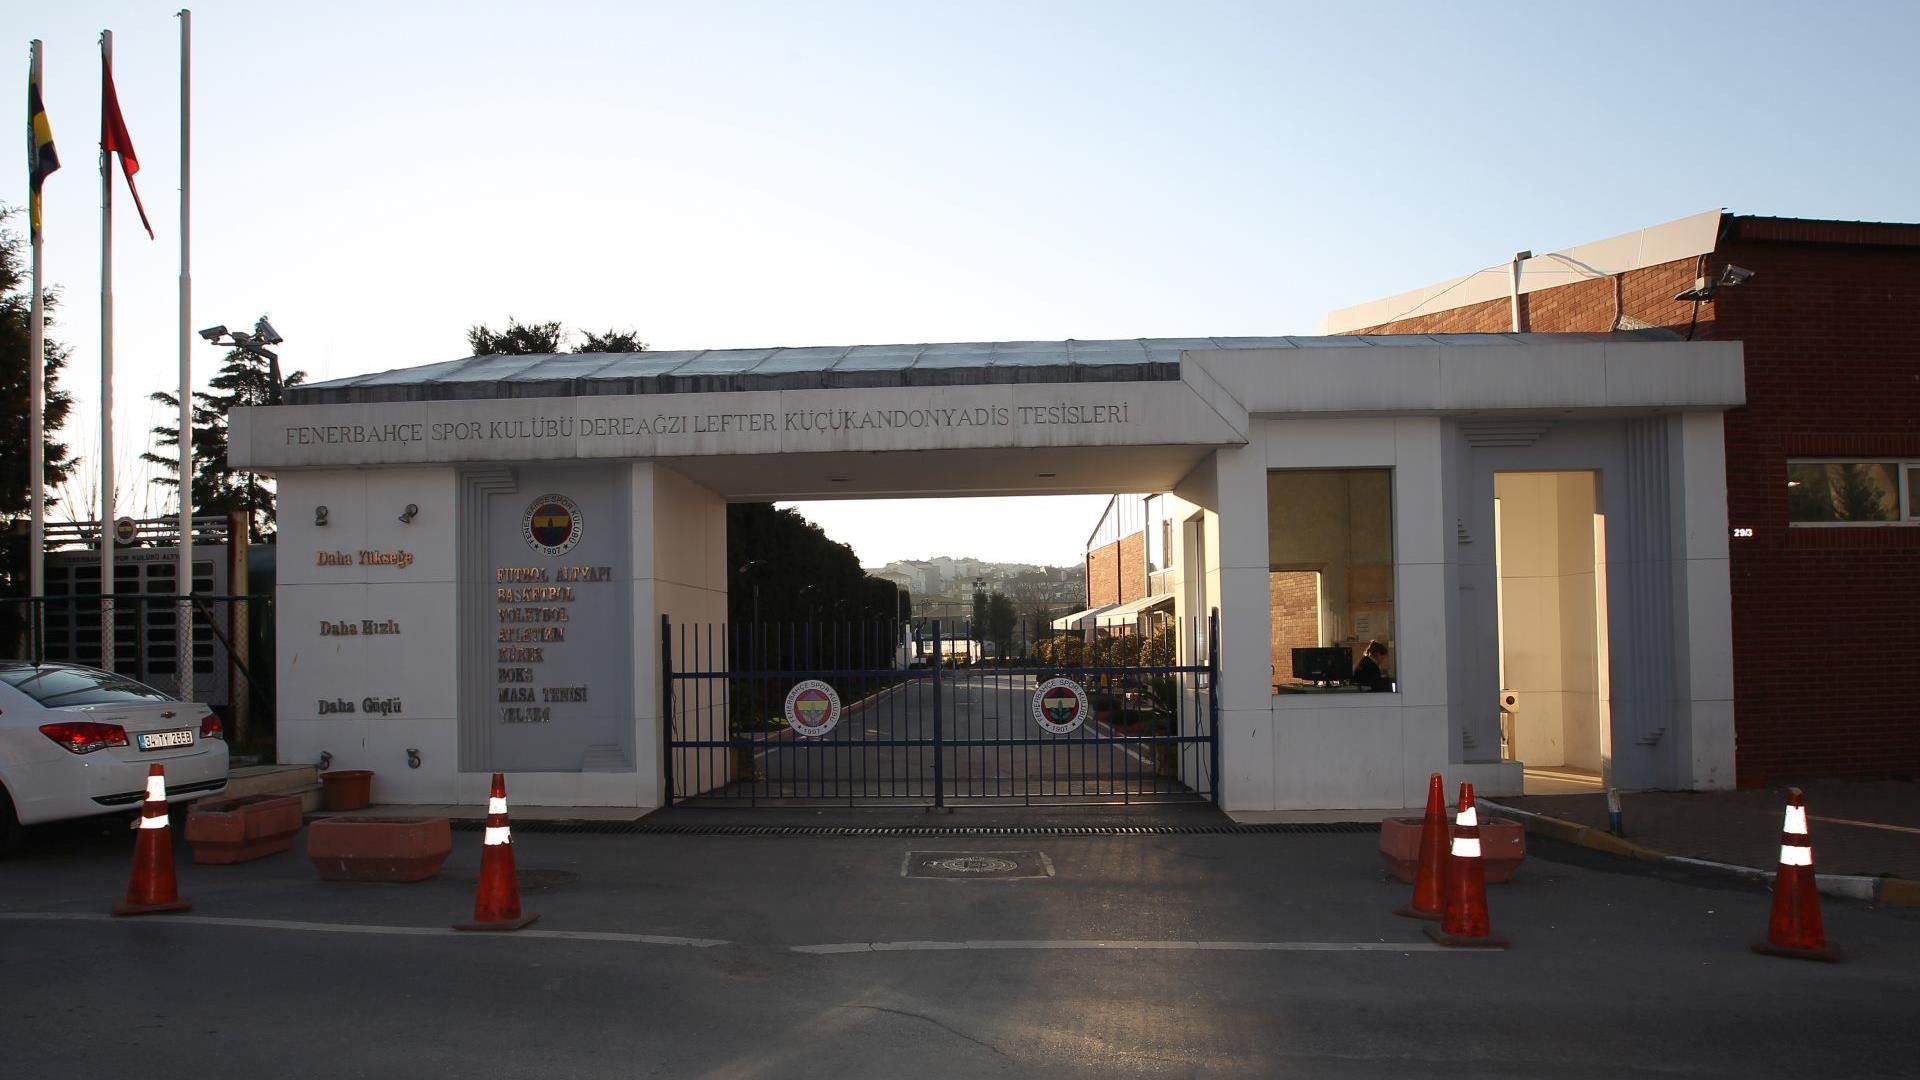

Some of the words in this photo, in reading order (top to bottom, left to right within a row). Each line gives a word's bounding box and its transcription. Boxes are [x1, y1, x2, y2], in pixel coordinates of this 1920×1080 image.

[286, 424, 423, 447] FENERBAHÇE
[431, 422, 484, 441] SPOR
[489, 415, 575, 439] KULÜBÜ
[580, 413, 688, 437] DEREAĞZI
[694, 412, 778, 433] LEFTER
[784, 404, 1010, 434] KÜÇÜKANDONYADİS
[1018, 401, 1130, 426] TESİSLERİ
[1733, 528, 1753, 537] 29/3
[543, 546, 562, 555] 1907
[317, 550, 352, 566] Daha
[359, 549, 413, 569] Yükseğe
[497, 567, 549, 583] FUTBOL
[556, 566, 613, 582] ALTYAPI
[497, 586, 575, 602] BASKETBOL
[498, 607, 570, 622] VOLEYBOL
[320, 620, 357, 636] Daha
[361, 619, 400, 635] Hızlı
[498, 667, 533, 683] BOKS
[498, 687, 536, 703] MASA
[318, 697, 355, 715] Daha
[362, 697, 402, 716] Güçlü
[145, 736, 156, 747] 34
